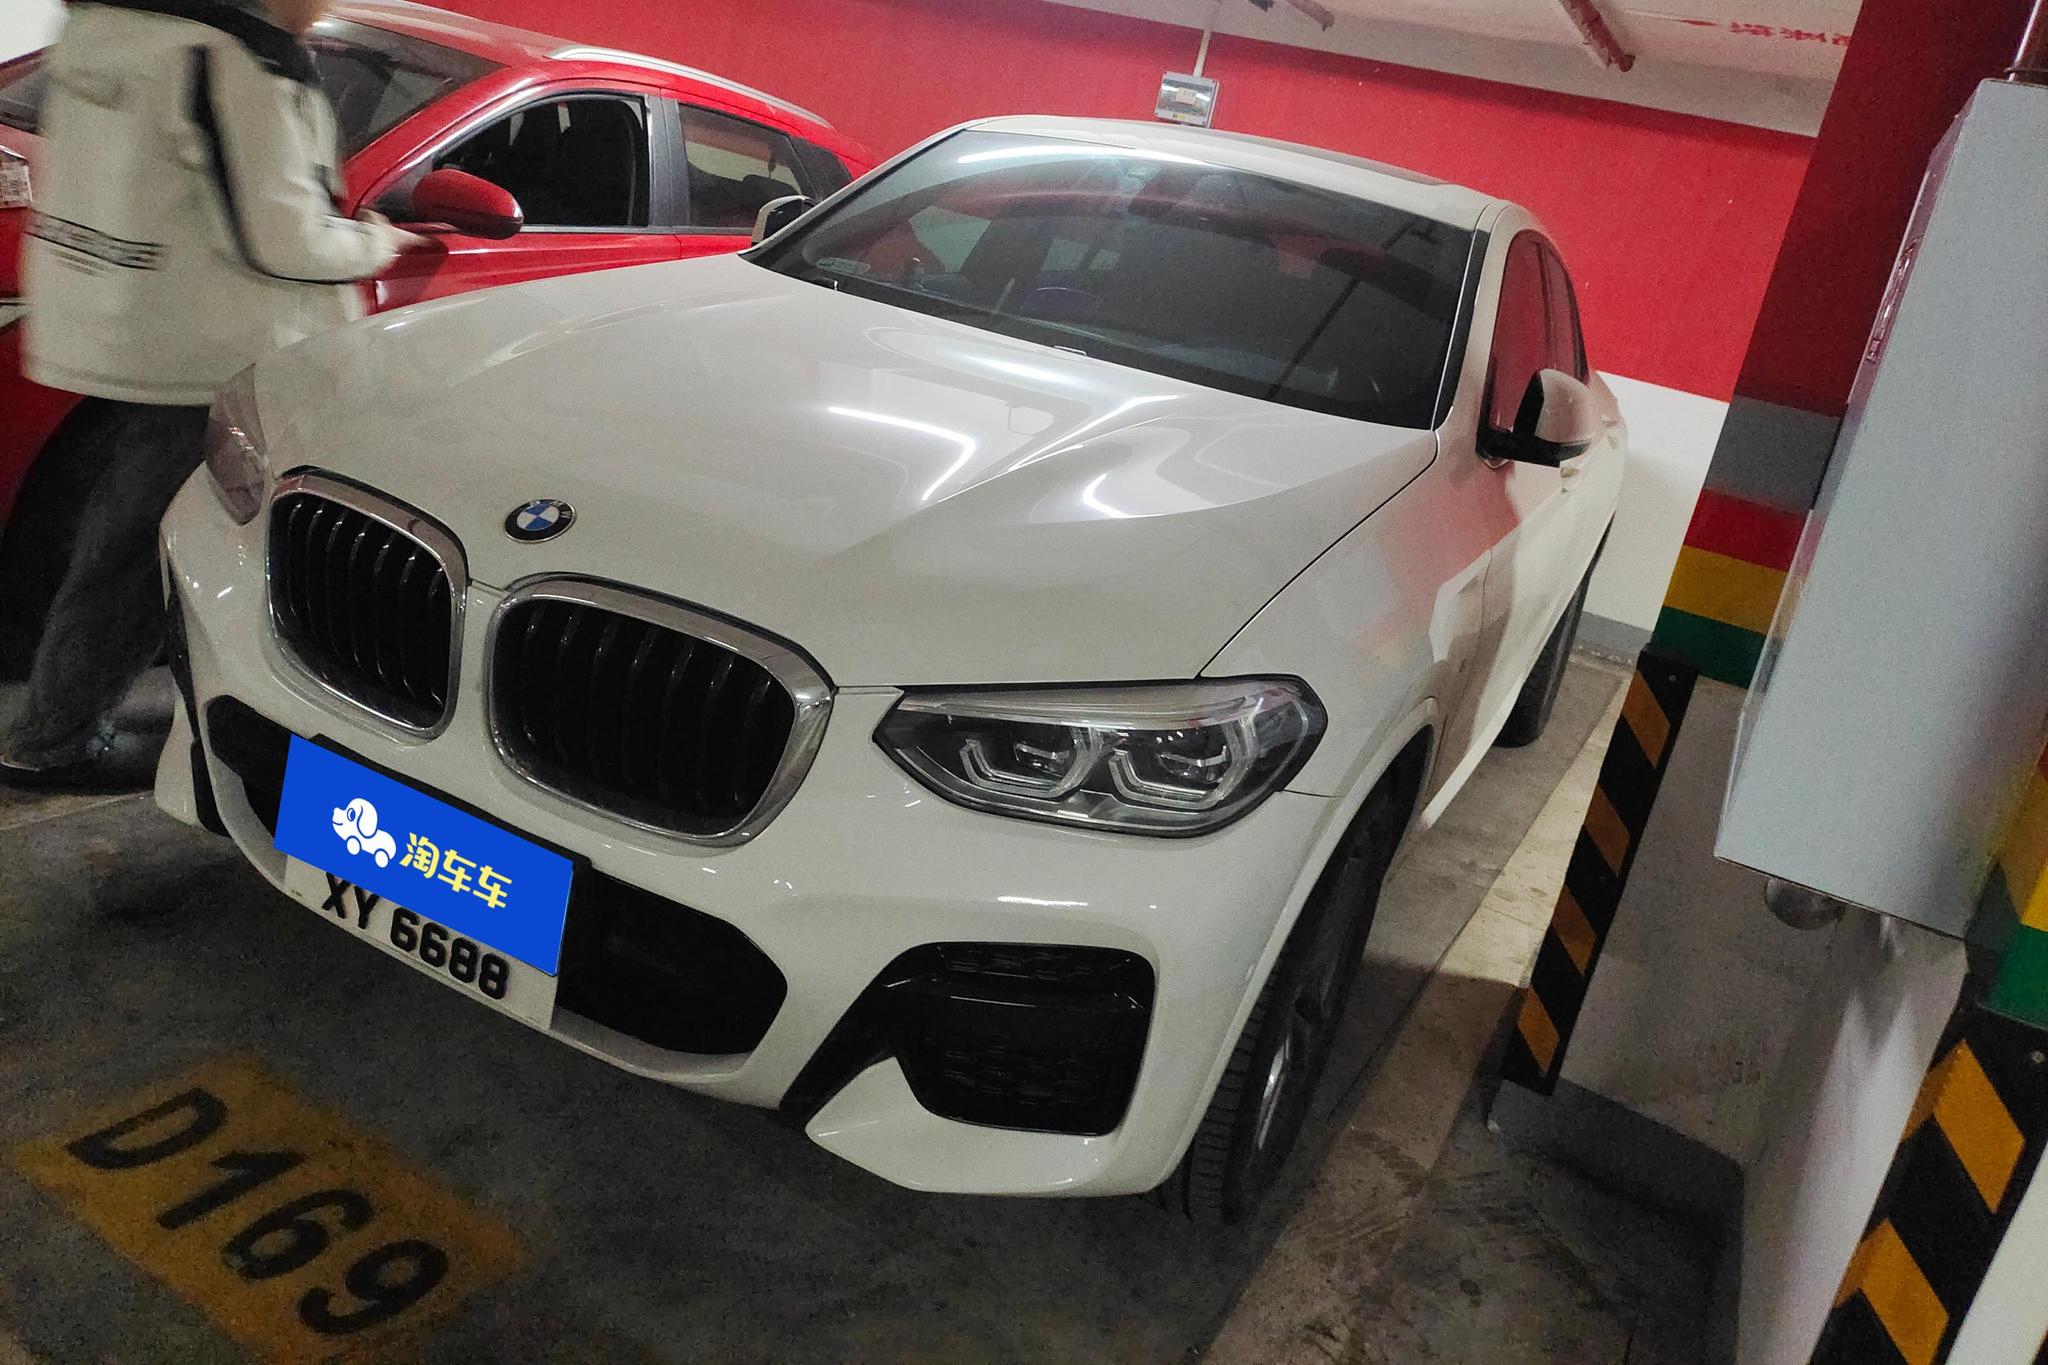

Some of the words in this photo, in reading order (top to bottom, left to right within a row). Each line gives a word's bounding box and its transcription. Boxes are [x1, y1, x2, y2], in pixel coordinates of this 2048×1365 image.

[321, 872, 380, 930] XY
[389, 906, 511, 1001] 6688
[66, 1086, 450, 1337] D169
